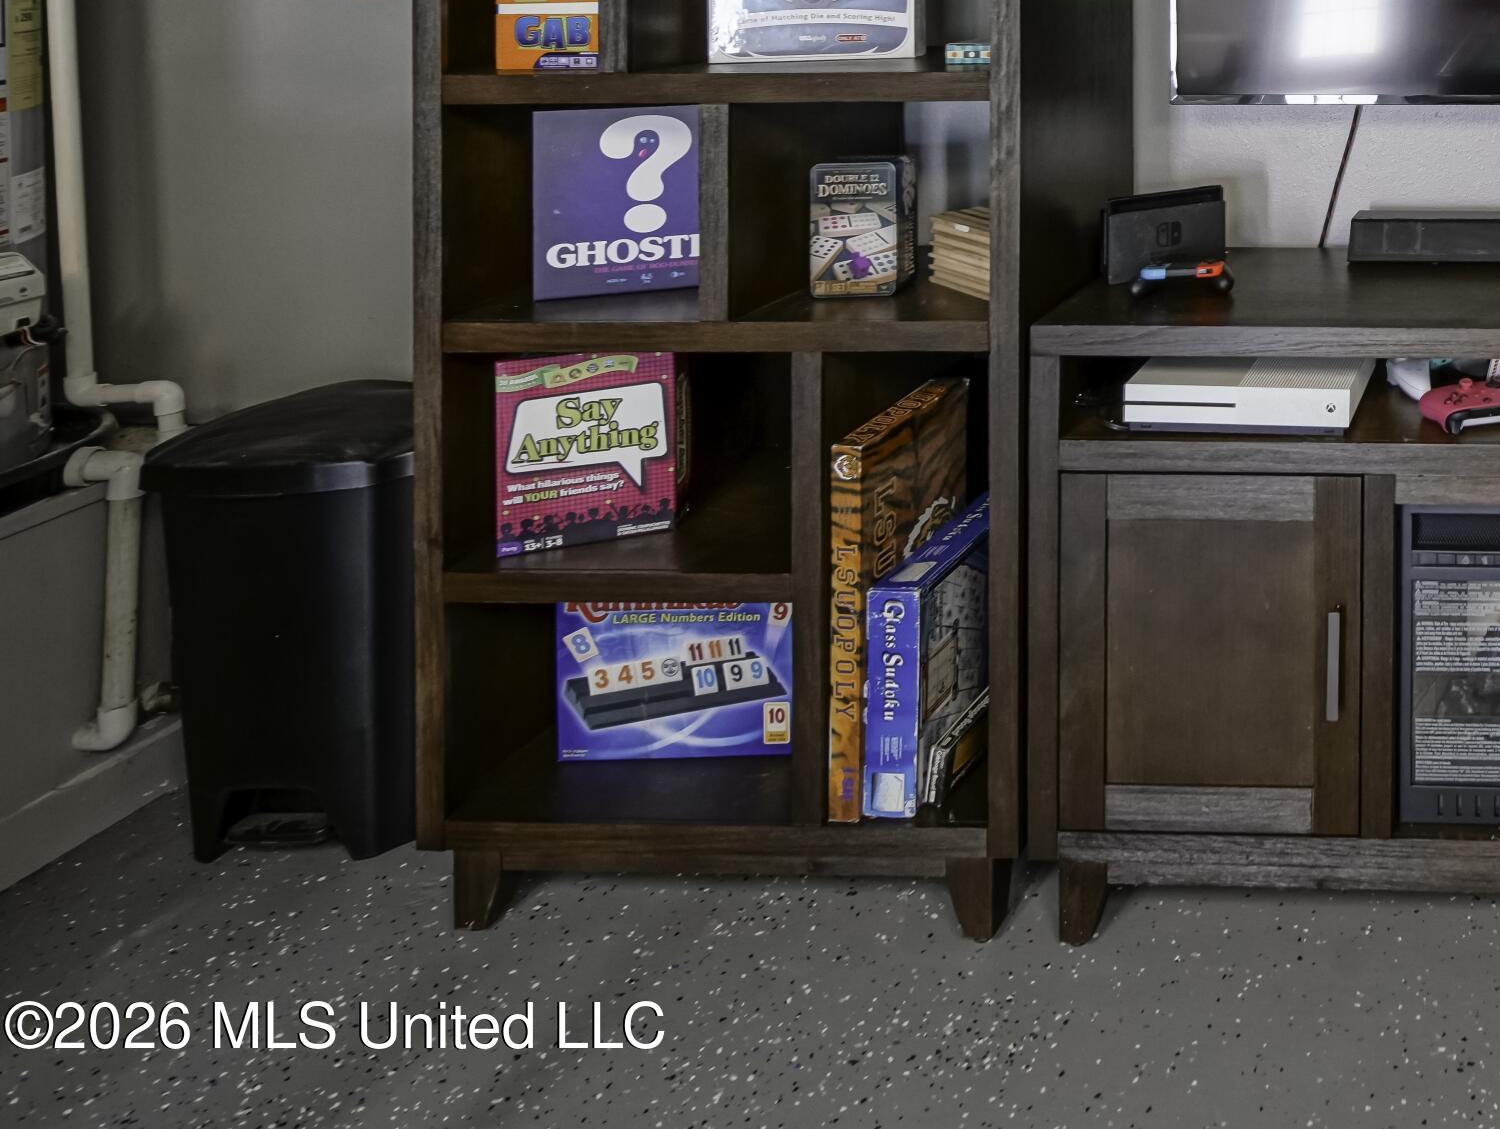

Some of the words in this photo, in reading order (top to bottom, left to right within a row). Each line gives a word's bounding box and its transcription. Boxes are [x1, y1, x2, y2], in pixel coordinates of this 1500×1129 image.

[771, 13, 809, 22] Matching
[811, 12, 824, 20] Die
[826, 12, 840, 20] and
[843, 13, 872, 23] Scoring
[514, 15, 593, 50] GAB
[817, 183, 888, 198] DOMINOES
[824, 174, 868, 184] DOUBLE
[555, 396, 623, 429] Say
[511, 421, 659, 464] Anything
[502, 495, 524, 506] will
[524, 490, 559, 503] YOUR
[559, 484, 598, 498] friends
[599, 480, 625, 492] say?
[507, 481, 536, 493] What
[537, 476, 585, 489] hilarious
[585, 472, 620, 484] things
[612, 613, 657, 624] LARGE
[660, 612, 714, 623] Numbers
[718, 611, 761, 622] Edition
[772, 602, 788, 620] 9
[881, 598, 906, 649] Glass
[569, 633, 592, 654] 8
[833, 544, 859, 721] LSUOPOLY
[688, 641, 704, 661] 11
[707, 639, 723, 659] 11
[727, 637, 741, 656] 11
[594, 668, 610, 689] 3
[618, 664, 634, 684] 4
[641, 660, 656, 680] 5
[696, 667, 715, 689] 10
[730, 664, 743, 682] 9
[750, 660, 764, 679] 9
[881, 652, 904, 721] Sudoku
[768, 707, 785, 724] 10
